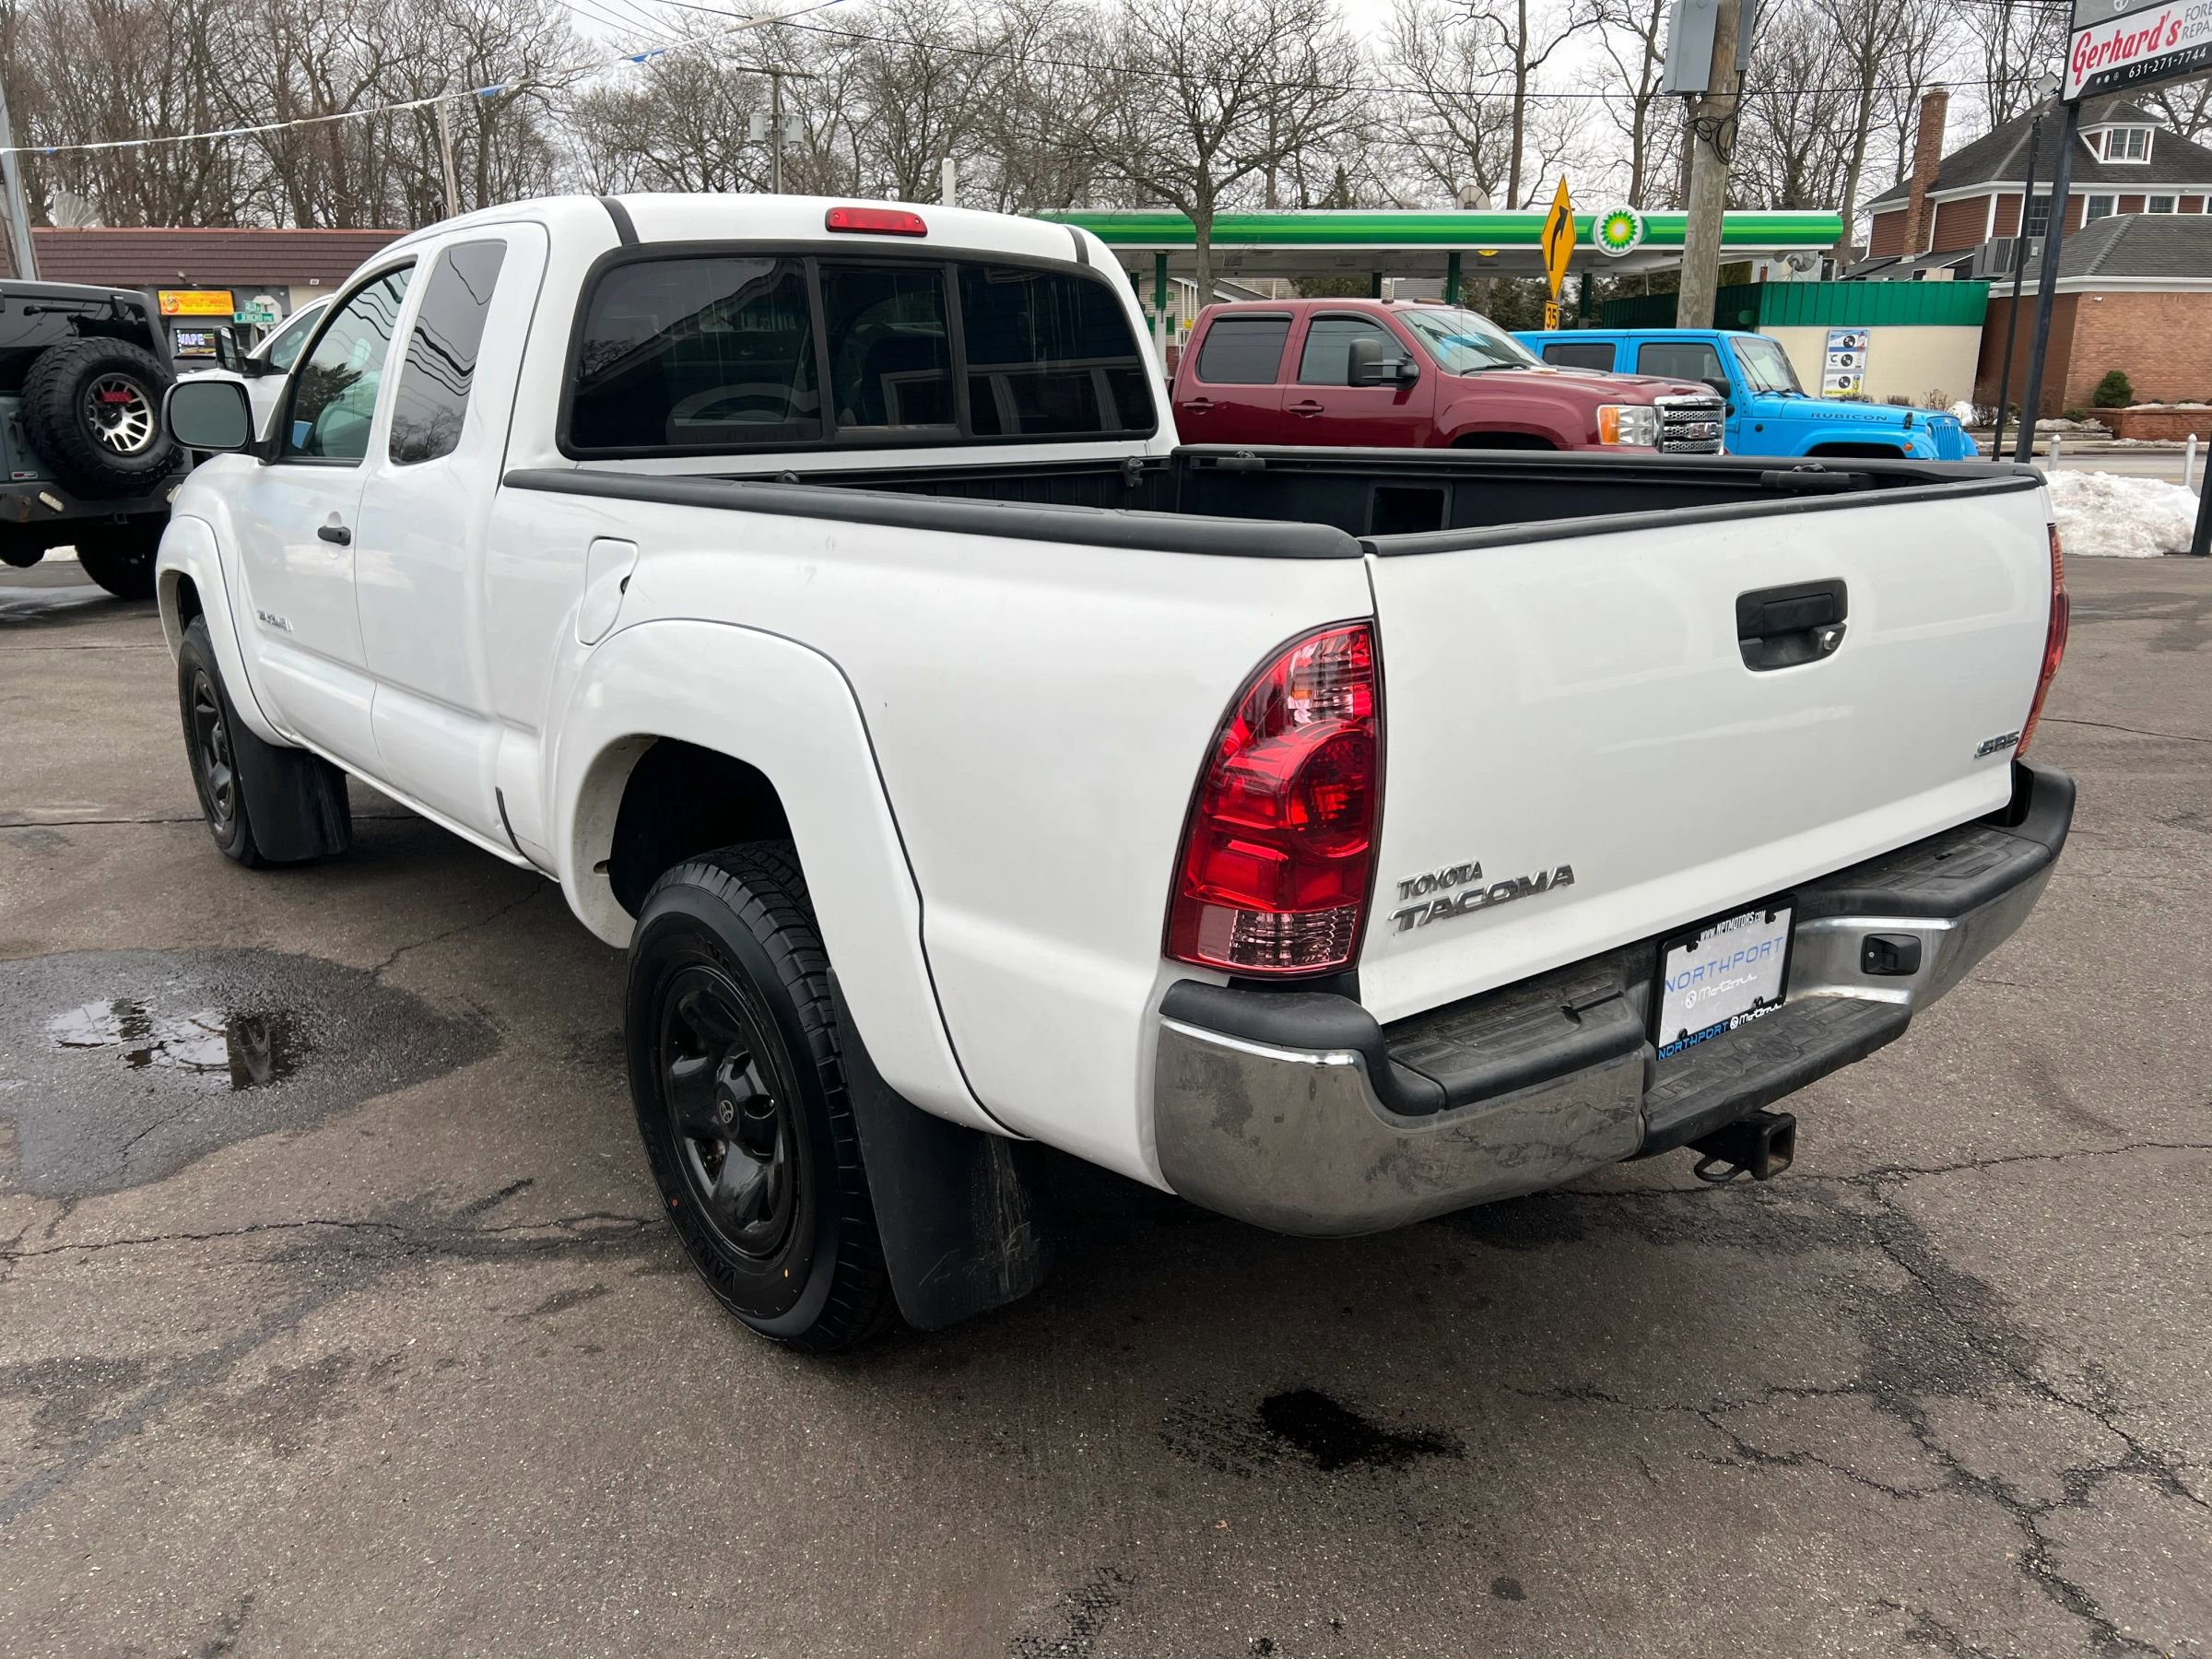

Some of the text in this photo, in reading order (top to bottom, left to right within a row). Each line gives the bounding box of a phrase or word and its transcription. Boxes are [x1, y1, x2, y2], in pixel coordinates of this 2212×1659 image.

[2182, 19, 2212, 41] REPA
[2073, 10, 2183, 86] Gerhard's
[2128, 47, 2206, 78] 631-271-7744
[1547, 307, 1558, 330] 35
[180, 333, 206, 346] VAPE
[1811, 412, 1888, 421] RUBICON
[1397, 861, 1484, 900] TOYOTA
[1388, 864, 1575, 932] TACOMA
[1665, 936, 1784, 994] NORTHPORT
[1698, 973, 1758, 1001] Motors
[1659, 1003, 1783, 1060] NORTHPORT Motors
